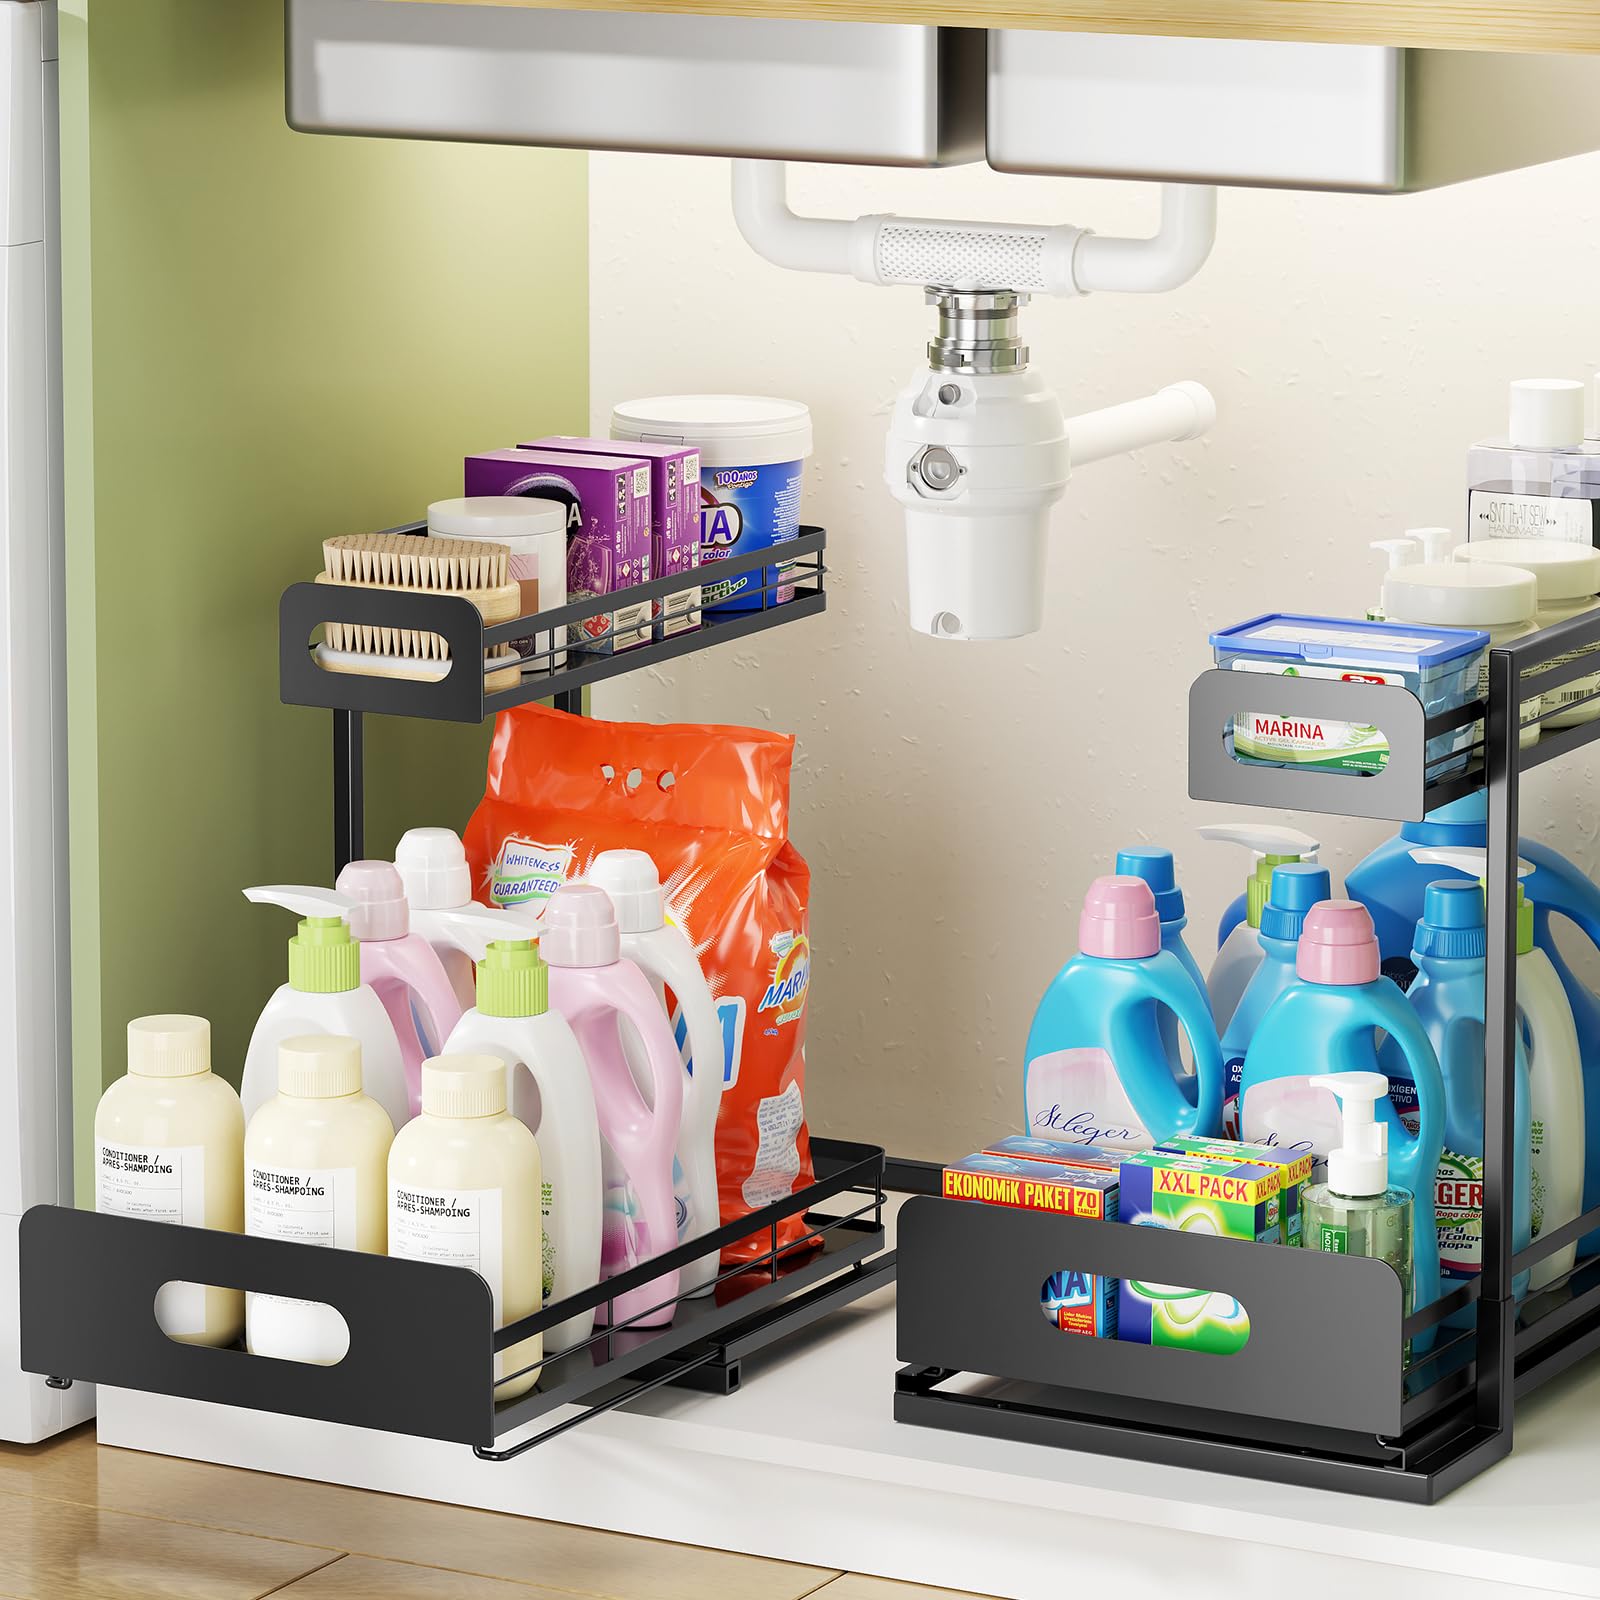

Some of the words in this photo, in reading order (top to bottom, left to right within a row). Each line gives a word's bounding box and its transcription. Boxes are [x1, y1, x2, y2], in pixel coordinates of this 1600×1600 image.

[703, 549, 731, 560] color
[1255, 718, 1324, 741] MARINA
[506, 854, 561, 872] WHITENESS
[1388, 1084, 1417, 1095] XÍGEN
[102, 1147, 148, 1163] CONDITIONER
[252, 1169, 300, 1185] CONDITIONER
[1159, 1169, 1196, 1195] XXL
[1200, 1176, 1249, 1203] PACK
[396, 1190, 446, 1207] CONDITIONER
[1024, 1183, 1071, 1211] PAKET
[1076, 1191, 1097, 1209] 70
[1077, 1207, 1097, 1215] TABLET
